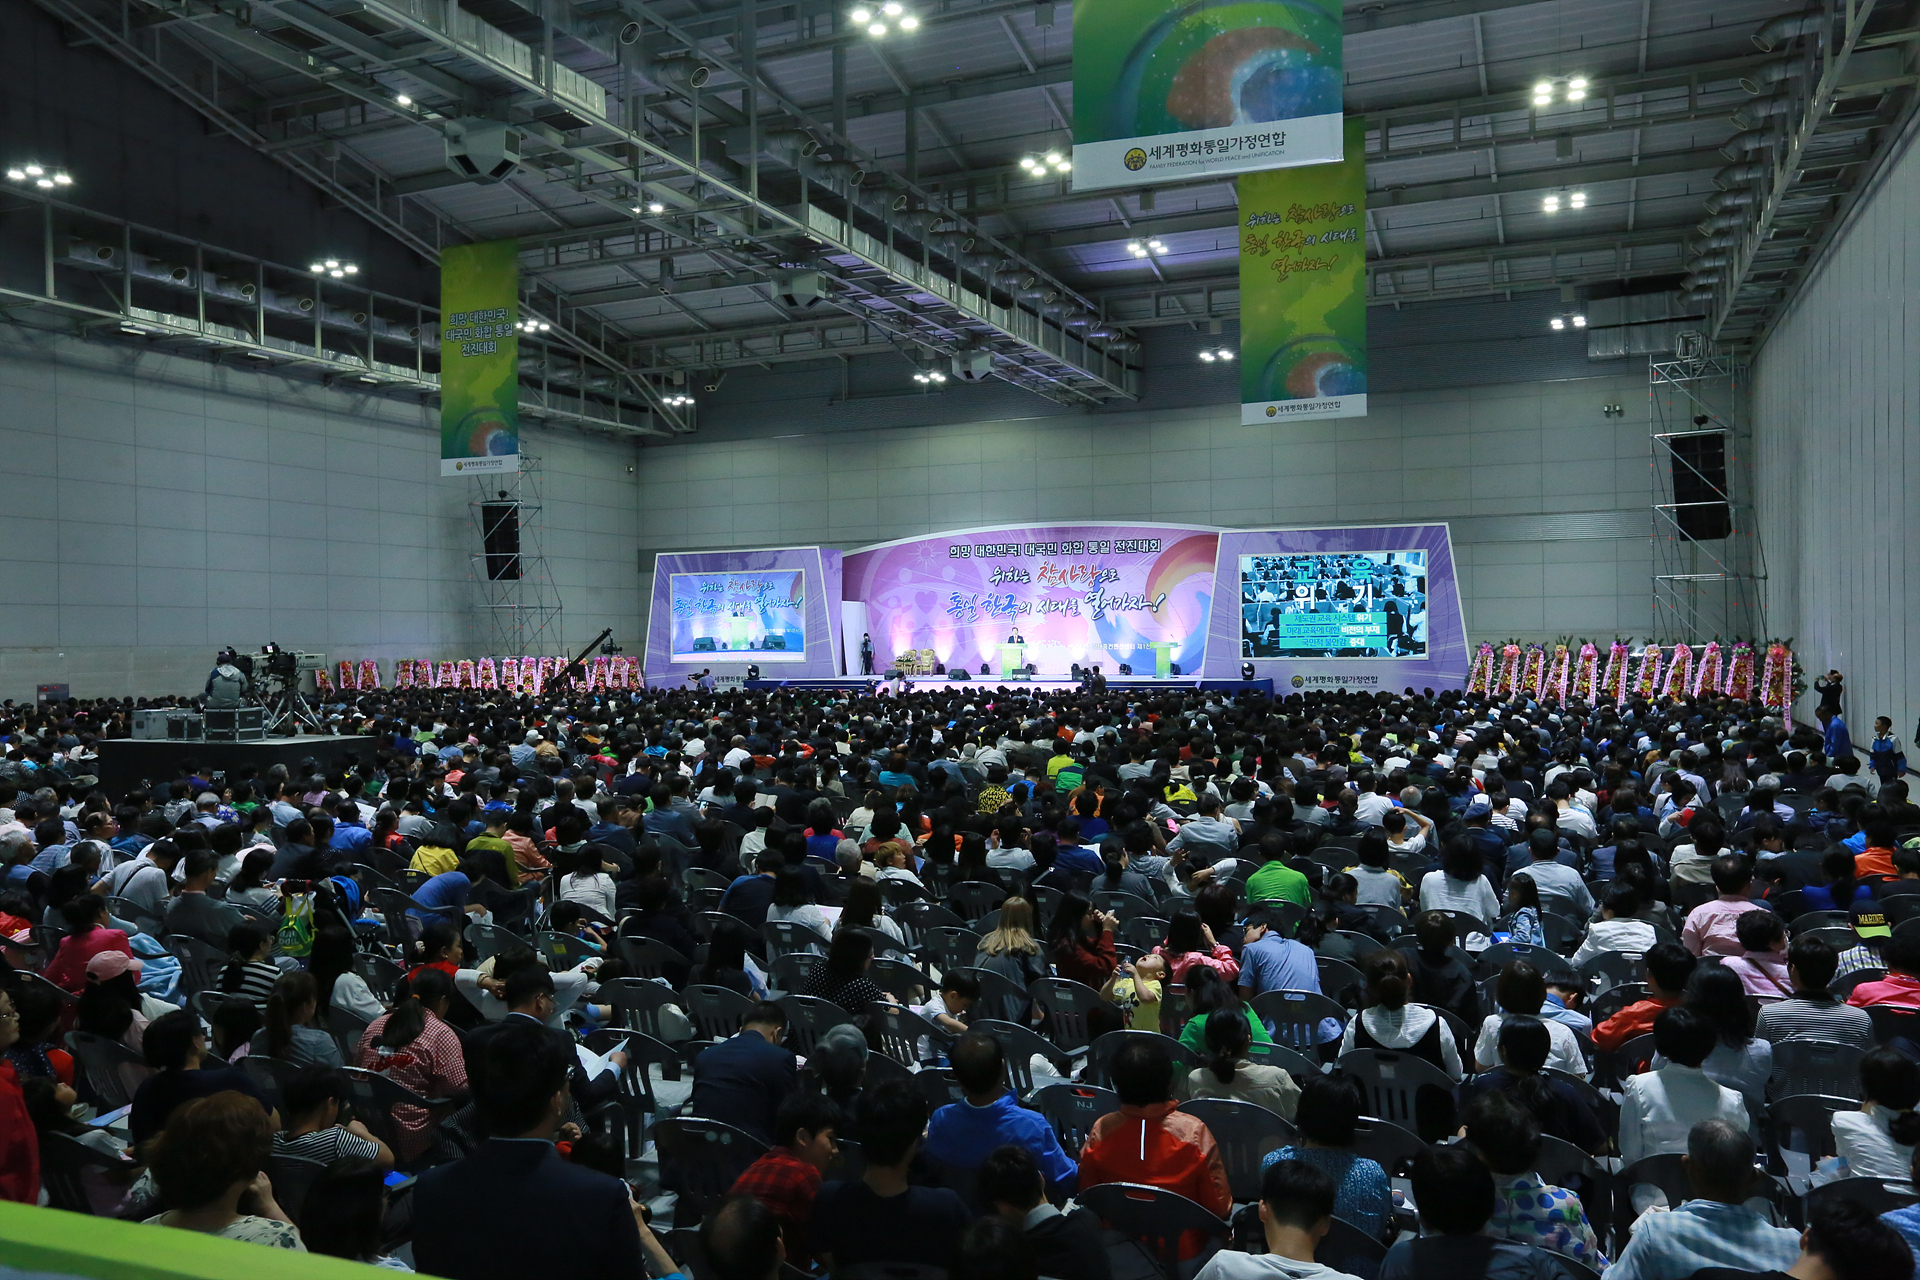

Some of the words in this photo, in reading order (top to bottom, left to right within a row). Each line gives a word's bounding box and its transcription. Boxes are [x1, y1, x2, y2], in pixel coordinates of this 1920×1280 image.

[1149, 132, 1286, 160] 세계평화통일가정연합
[1167, 160, 1198, 168] FEDERATION
[1205, 156, 1224, 164] WORLD
[1224, 154, 1241, 162] PEACE
[1252, 150, 1285, 158] UNIFICATION
[1245, 211, 1281, 229] 위하는
[1286, 202, 1356, 224] 참사랑으로
[1243, 234, 1270, 257] 통일
[1272, 230, 1316, 255] 한국의
[1320, 228, 1357, 244] 시대를
[1271, 254, 1338, 282] 열어가자!
[450, 312, 468, 326] 희망
[469, 308, 509, 324] 대한민국!
[446, 328, 472, 342] 대국민
[474, 326, 492, 339] 화합
[494, 322, 513, 338] 통일
[461, 340, 497, 357] 전진대회
[1278, 401, 1341, 412] 세계평화통일가정연합
[949, 545, 972, 558] 희망
[974, 543, 1021, 558] 대한민국!
[1024, 542, 1058, 556] 대국민
[1060, 541, 1084, 555] 화합
[1087, 540, 1111, 554] 통일
[1114, 538, 1162, 554] 전진대회
[988, 566, 1032, 586] 위하는
[1036, 561, 1120, 587] 참사랑으로
[700, 581, 724, 594] 위하는
[727, 578, 775, 594] 참사랑으로
[674, 597, 693, 618] 통일
[694, 598, 724, 617] 한국의
[754, 593, 804, 614] 열어가자!
[946, 590, 979, 622] 통일
[980, 592, 1032, 624] 한국의
[1035, 597, 1080, 617] 시대를
[1083, 587, 1166, 620] 열어가자!
[1294, 614, 1316, 622] 제도권
[1317, 614, 1332, 622] 교육
[1334, 614, 1356, 622] 시스템
[1356, 614, 1372, 622] 위기
[1286, 626, 1301, 634] 미래
[1302, 626, 1324, 634] 교육에
[1326, 626, 1340, 634] 대한
[1341, 626, 1364, 634] 비전의
[1364, 626, 1380, 634] 부재
[1325, 638, 1346, 646] 불안감
[1348, 638, 1365, 646] 증대
[1305, 676, 1378, 684] 세계평화통일가정연합
[1857, 913, 1885, 924] MARINES
[1076, 1100, 1092, 1108] NJ
